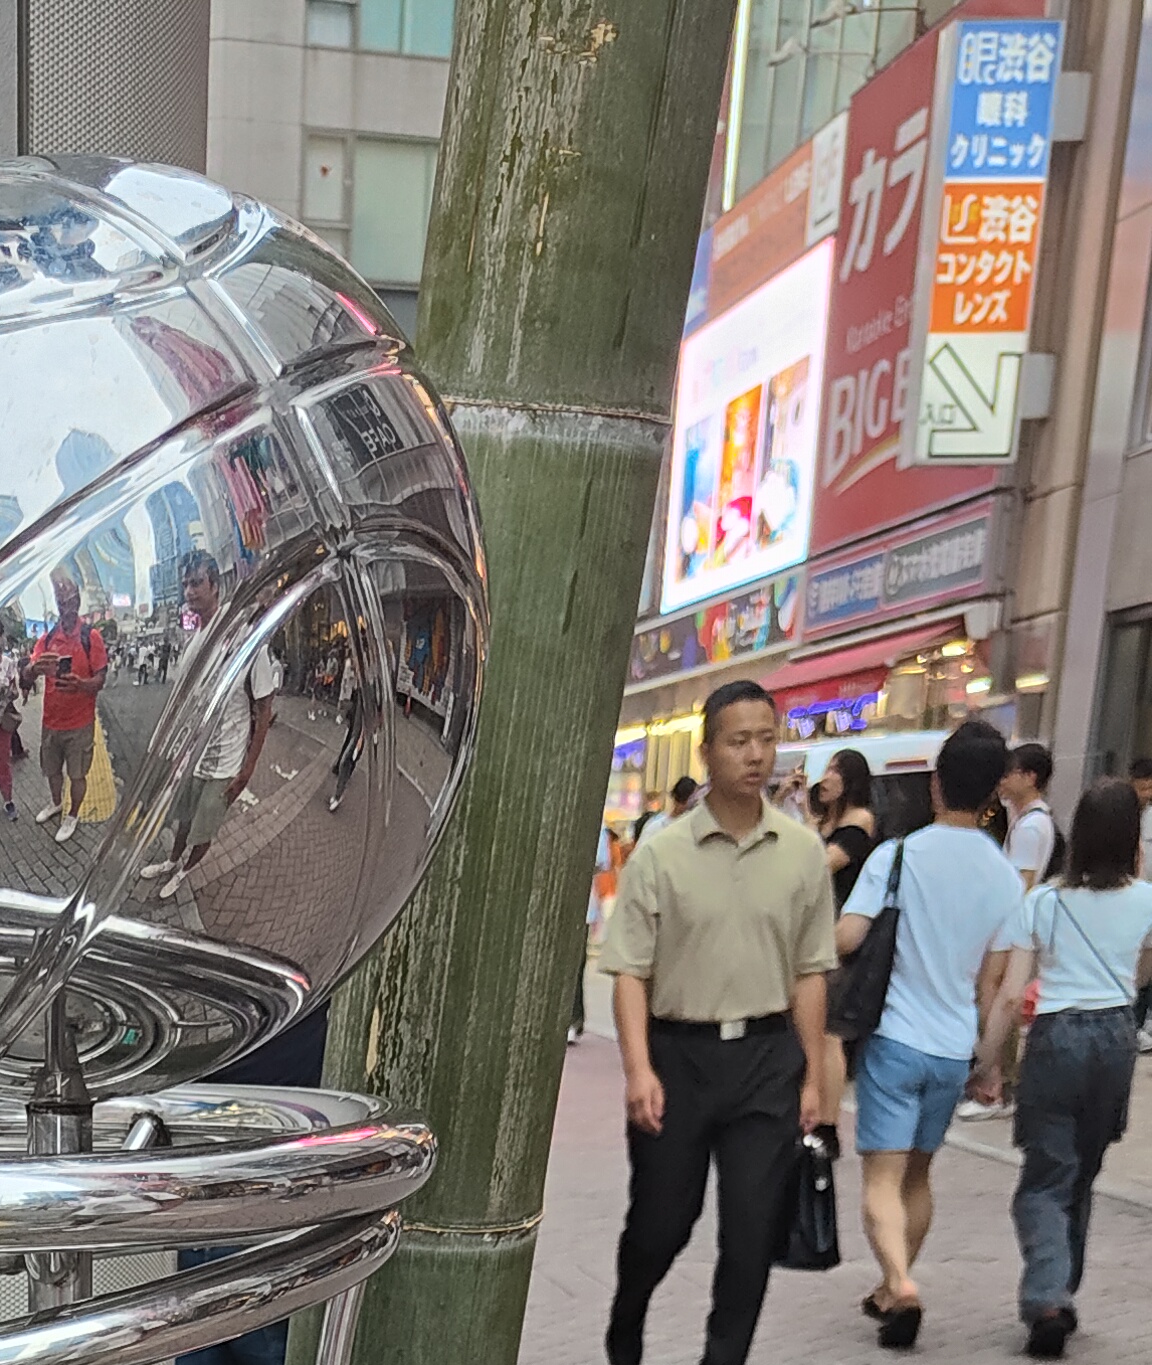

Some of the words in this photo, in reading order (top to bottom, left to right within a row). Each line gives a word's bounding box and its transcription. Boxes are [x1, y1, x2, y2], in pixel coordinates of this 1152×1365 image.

[950, 133, 1046, 168] クリニック
[936, 249, 1032, 285] コンタクト
[953, 289, 1011, 325] レンズ
[821, 358, 892, 489] BIG
